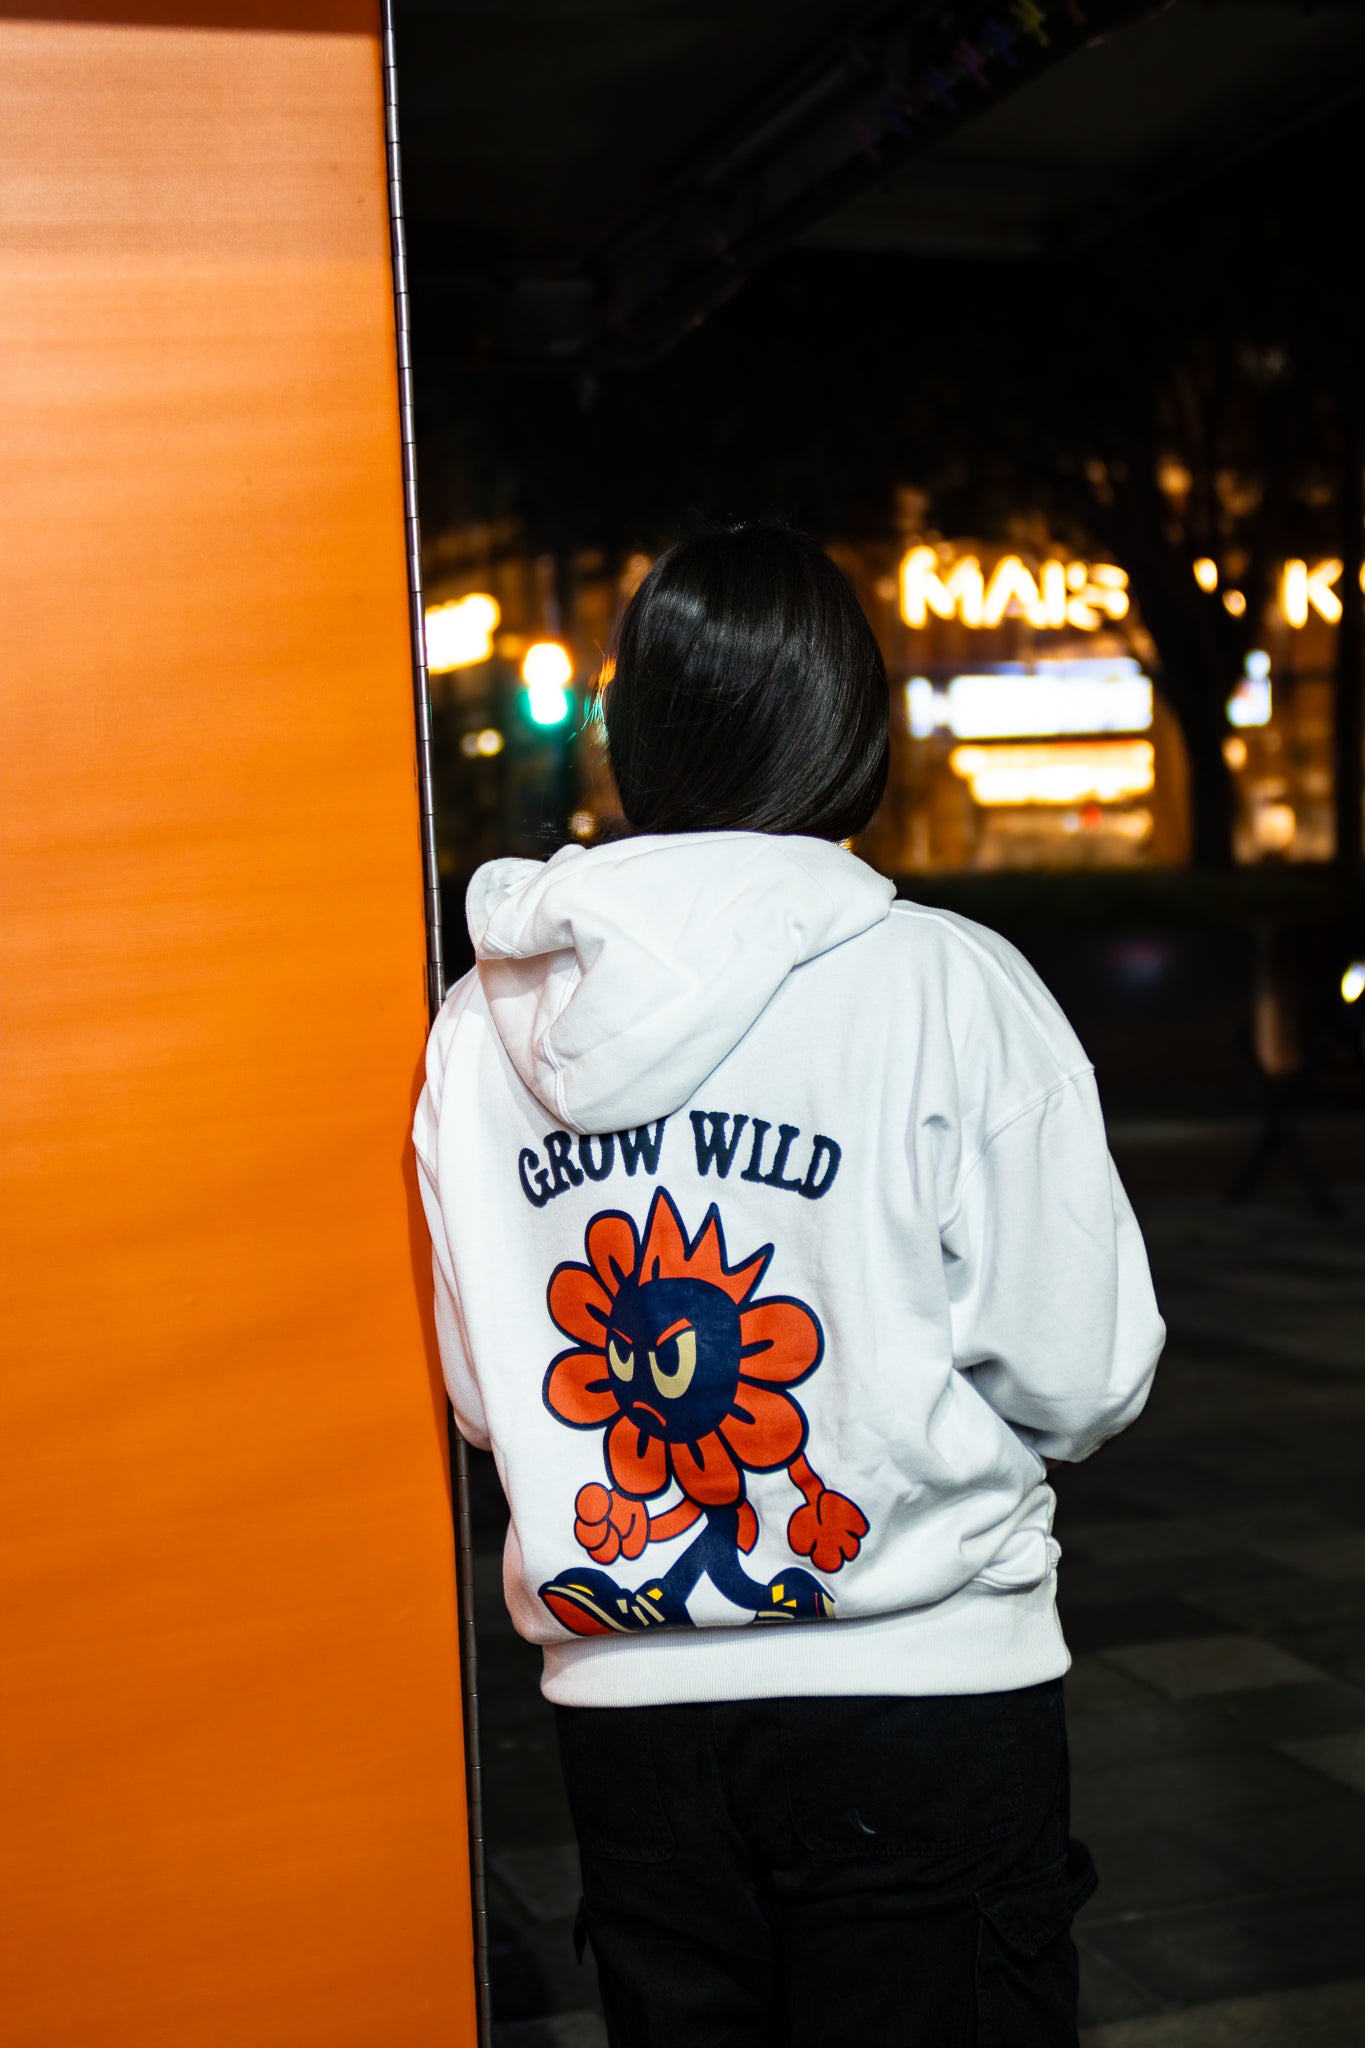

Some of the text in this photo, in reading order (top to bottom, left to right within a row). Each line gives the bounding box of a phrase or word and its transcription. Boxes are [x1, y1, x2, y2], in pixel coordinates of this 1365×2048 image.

[1284, 557, 1365, 629] K
[518, 1110, 842, 1208] GROW WILD
